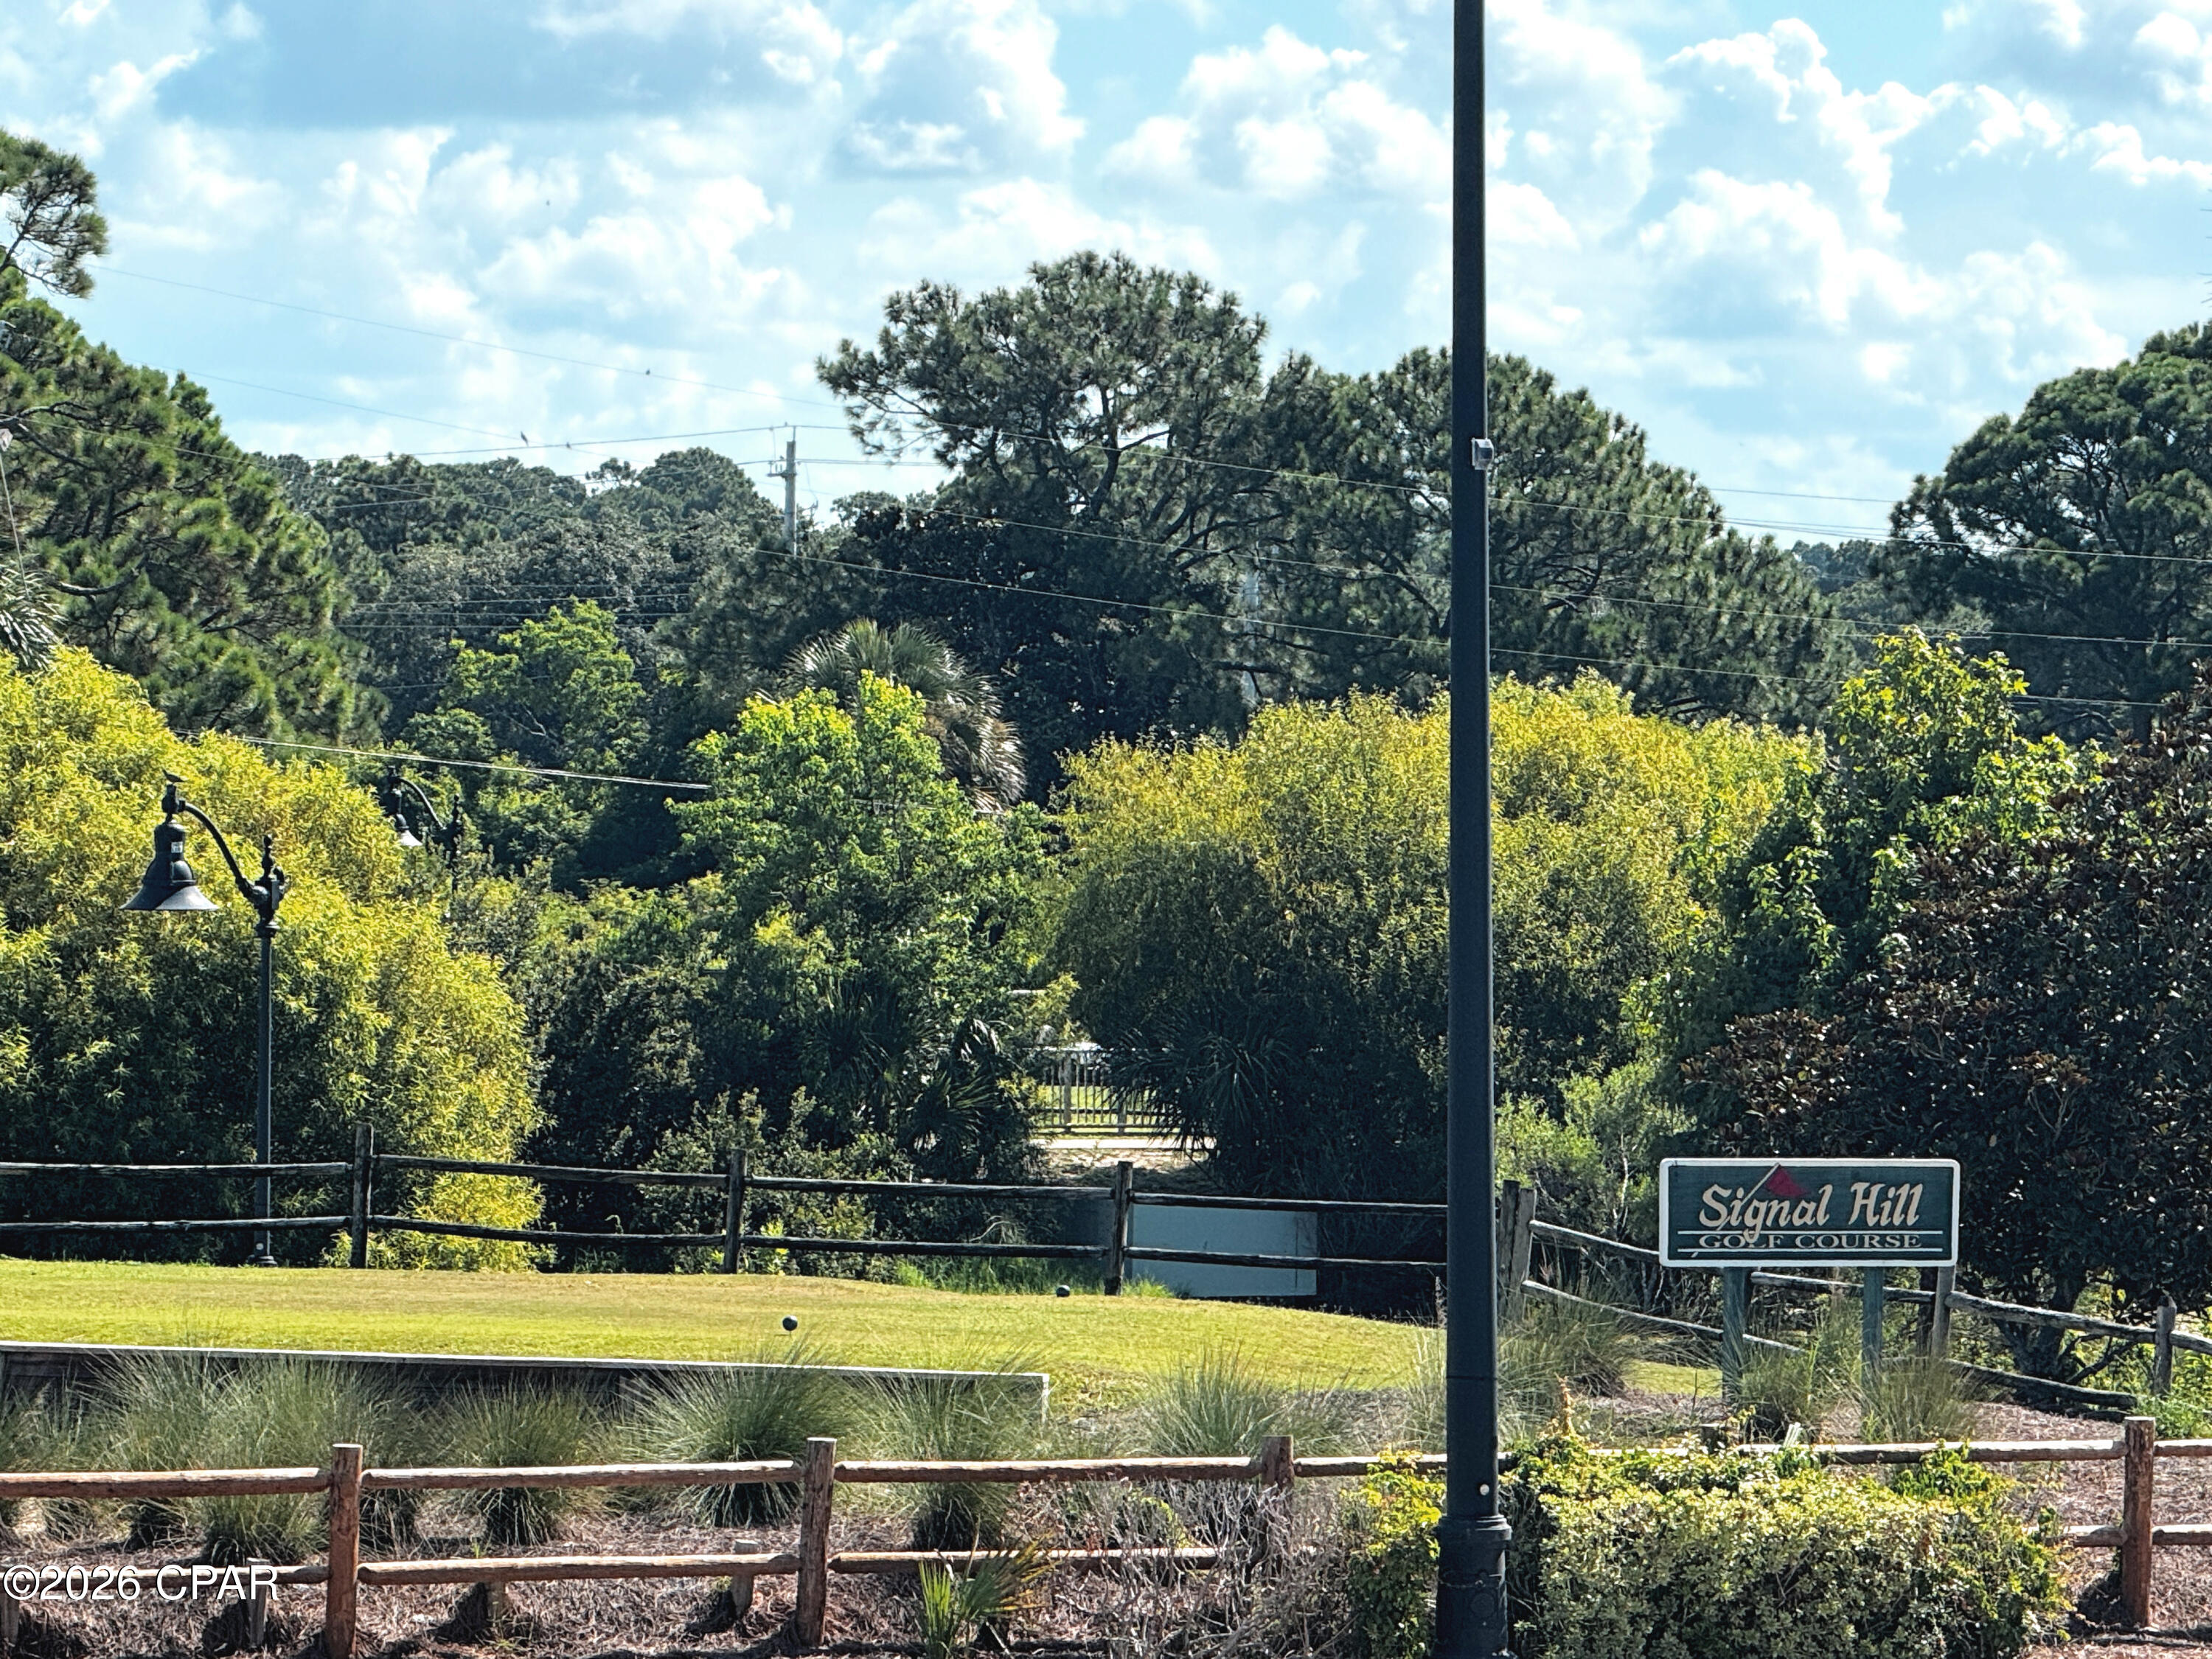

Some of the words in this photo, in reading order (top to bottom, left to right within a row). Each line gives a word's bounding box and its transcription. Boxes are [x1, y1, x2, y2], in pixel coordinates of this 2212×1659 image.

[1699, 1183, 1834, 1243] Signal
[1849, 1181, 1923, 1227] Hill
[1795, 1234, 1922, 1248] COURSE
